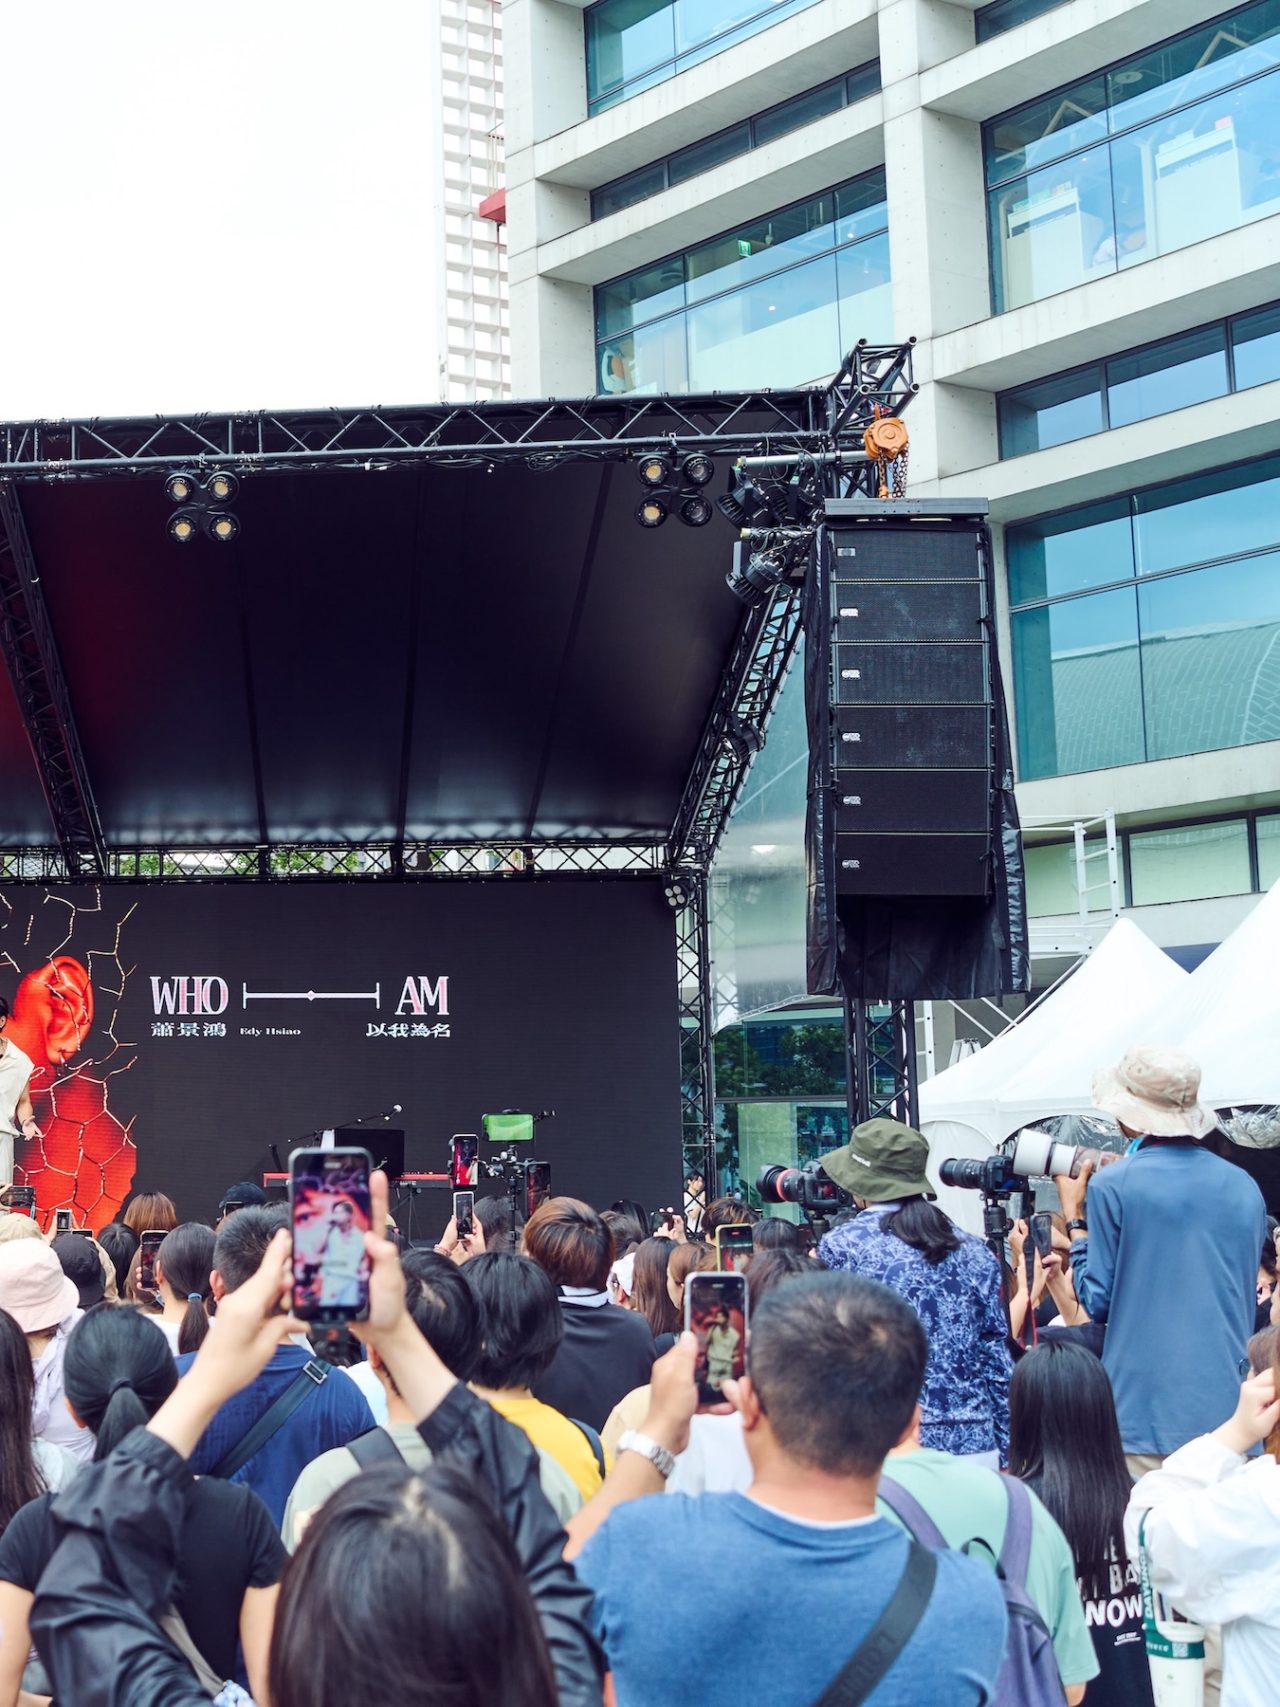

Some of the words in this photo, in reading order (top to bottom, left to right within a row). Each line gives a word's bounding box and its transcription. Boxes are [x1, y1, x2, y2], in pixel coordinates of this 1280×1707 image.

[150, 976, 229, 1015] WHO
[394, 976, 450, 1015] AM
[151, 1022, 227, 1037] 蕭景鴻
[239, 1027, 262, 1037] Edy
[266, 1027, 301, 1035] Hsiao
[366, 1022, 451, 1038] 以我為名
